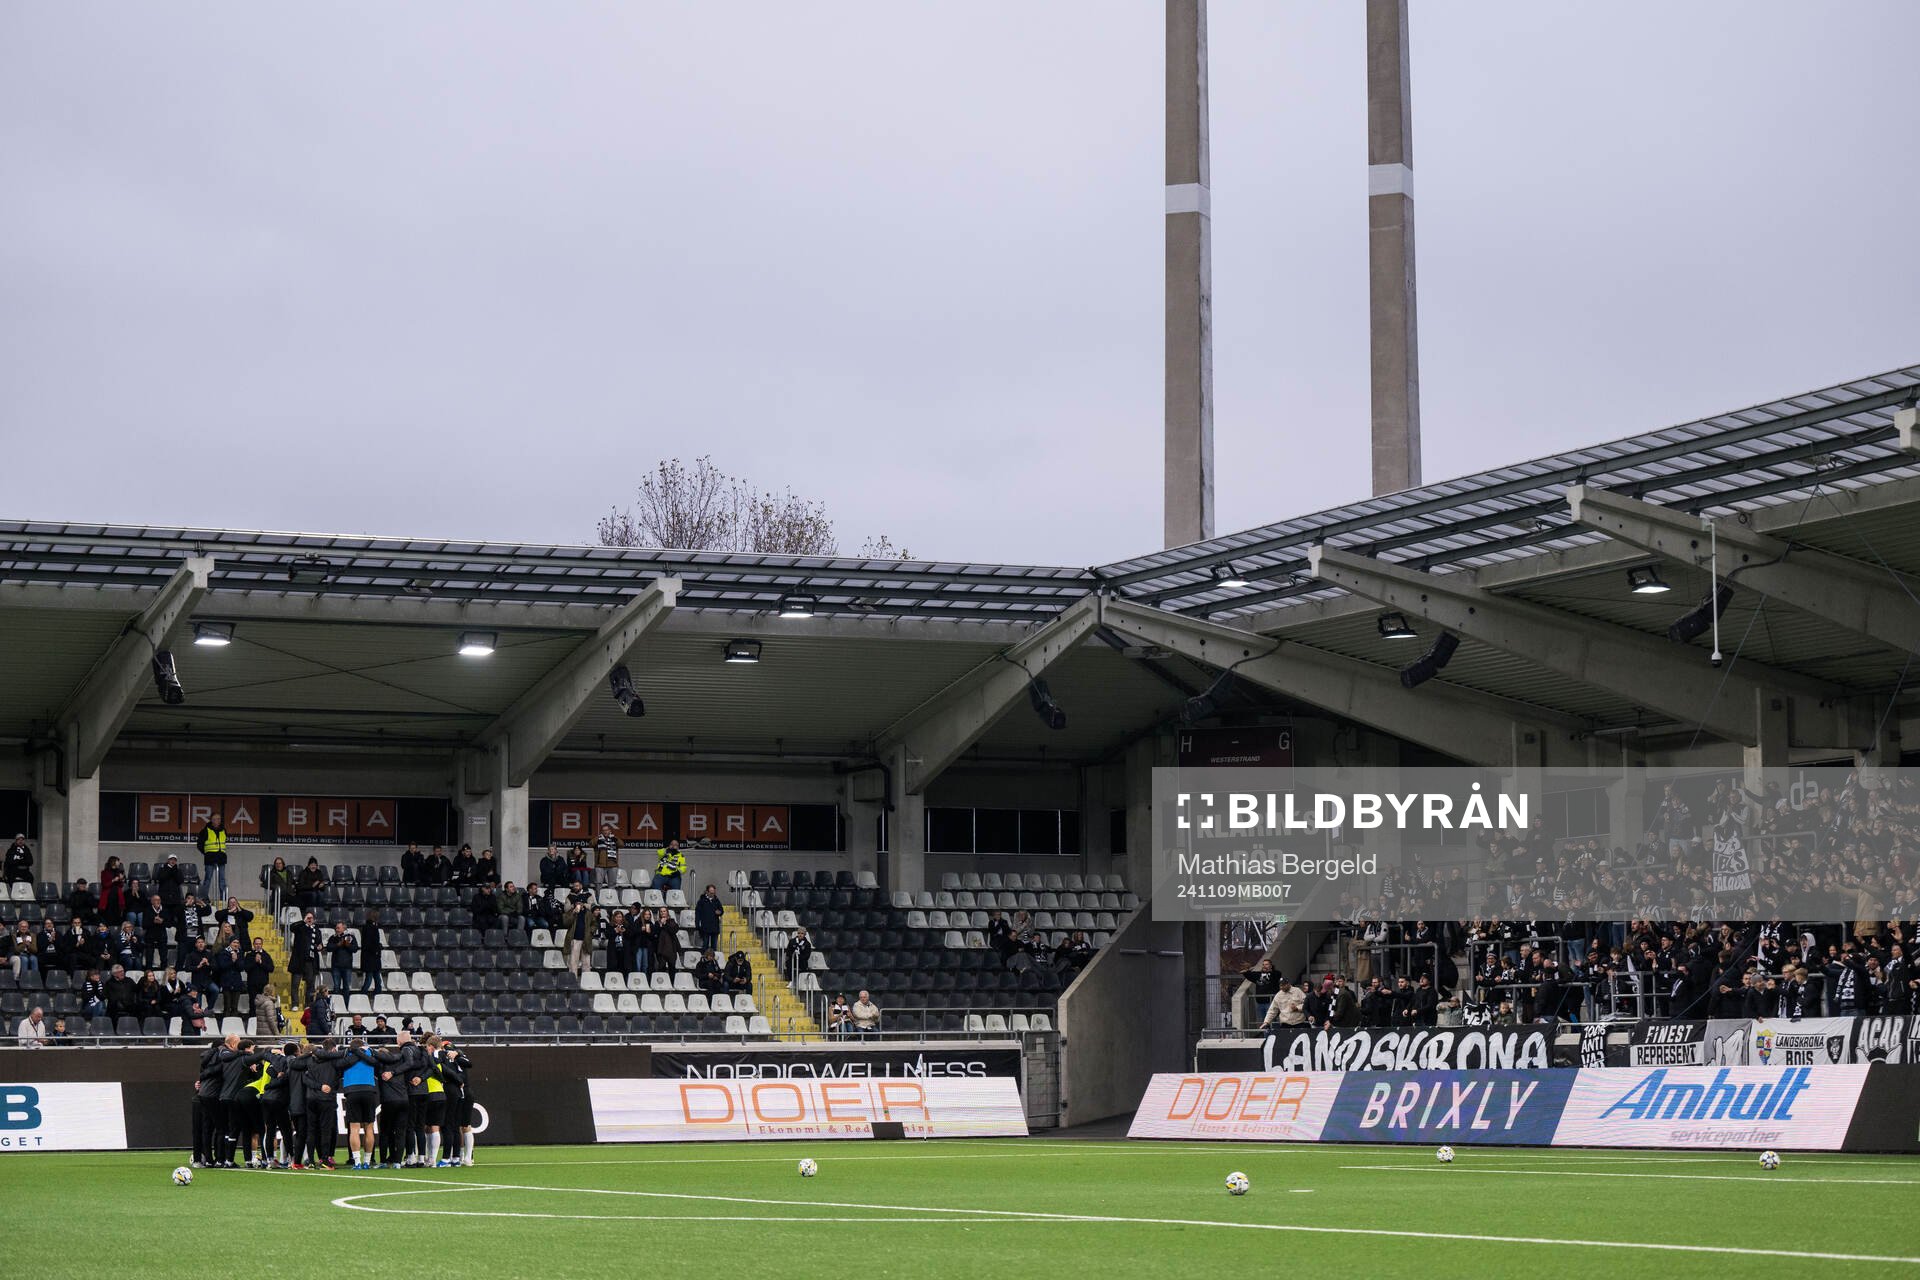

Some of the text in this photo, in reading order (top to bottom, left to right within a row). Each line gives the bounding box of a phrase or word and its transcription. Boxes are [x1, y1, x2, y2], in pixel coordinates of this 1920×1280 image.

[1181, 735, 1193, 753] H
[1278, 732, 1290, 750] G
[1210, 755, 1261, 763] WESTERSTRAND
[1645, 1025, 1694, 1043] FINEST
[1775, 1035, 1825, 1047] LANDSKRONA
[1858, 1017, 1905, 1051] ACAB
[1263, 1030, 1549, 1071] LANDSKRONA
[1581, 1036, 1604, 1054] ANTI
[1637, 1044, 1697, 1065] REPRESENT
[1785, 1050, 1814, 1065] BOIS
[1599, 1067, 1812, 1120] Amhult
[1359, 1081, 1539, 1129] BRIXLY
[759, 1125, 821, 1135] Ekonomi
[1669, 1127, 1784, 1146] servicepartner
